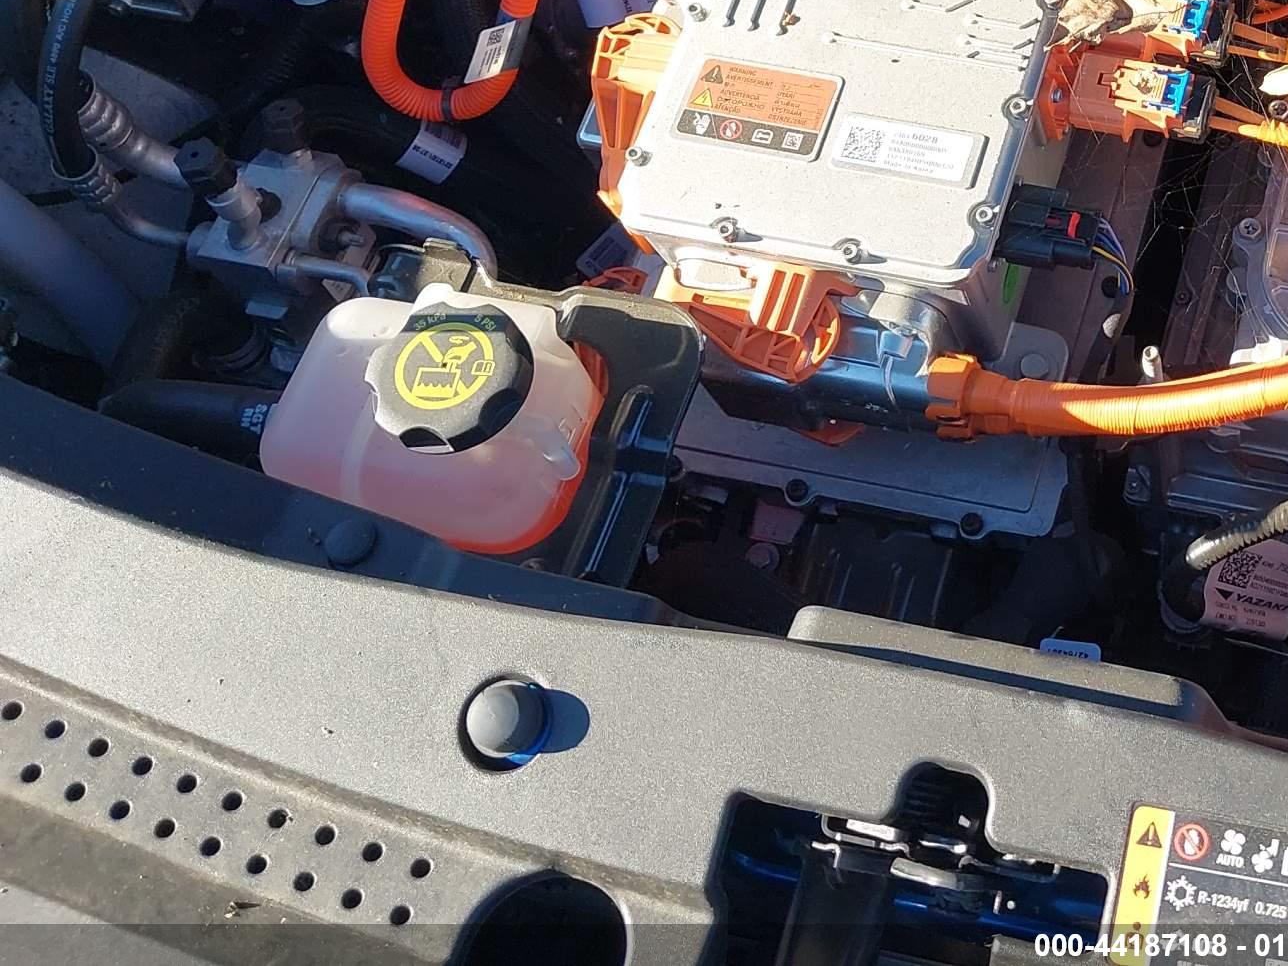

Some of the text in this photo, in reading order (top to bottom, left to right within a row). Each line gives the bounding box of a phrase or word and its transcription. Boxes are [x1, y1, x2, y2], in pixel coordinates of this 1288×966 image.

[413, 312, 447, 332] 35 kPa
[473, 313, 498, 332] 5 PSI
[1237, 593, 1288, 611] YAZAKI
[1215, 853, 1245, 869] AUTO
[1197, 890, 1250, 914] R-1234yf
[1254, 902, 1288, 921] 0.725
